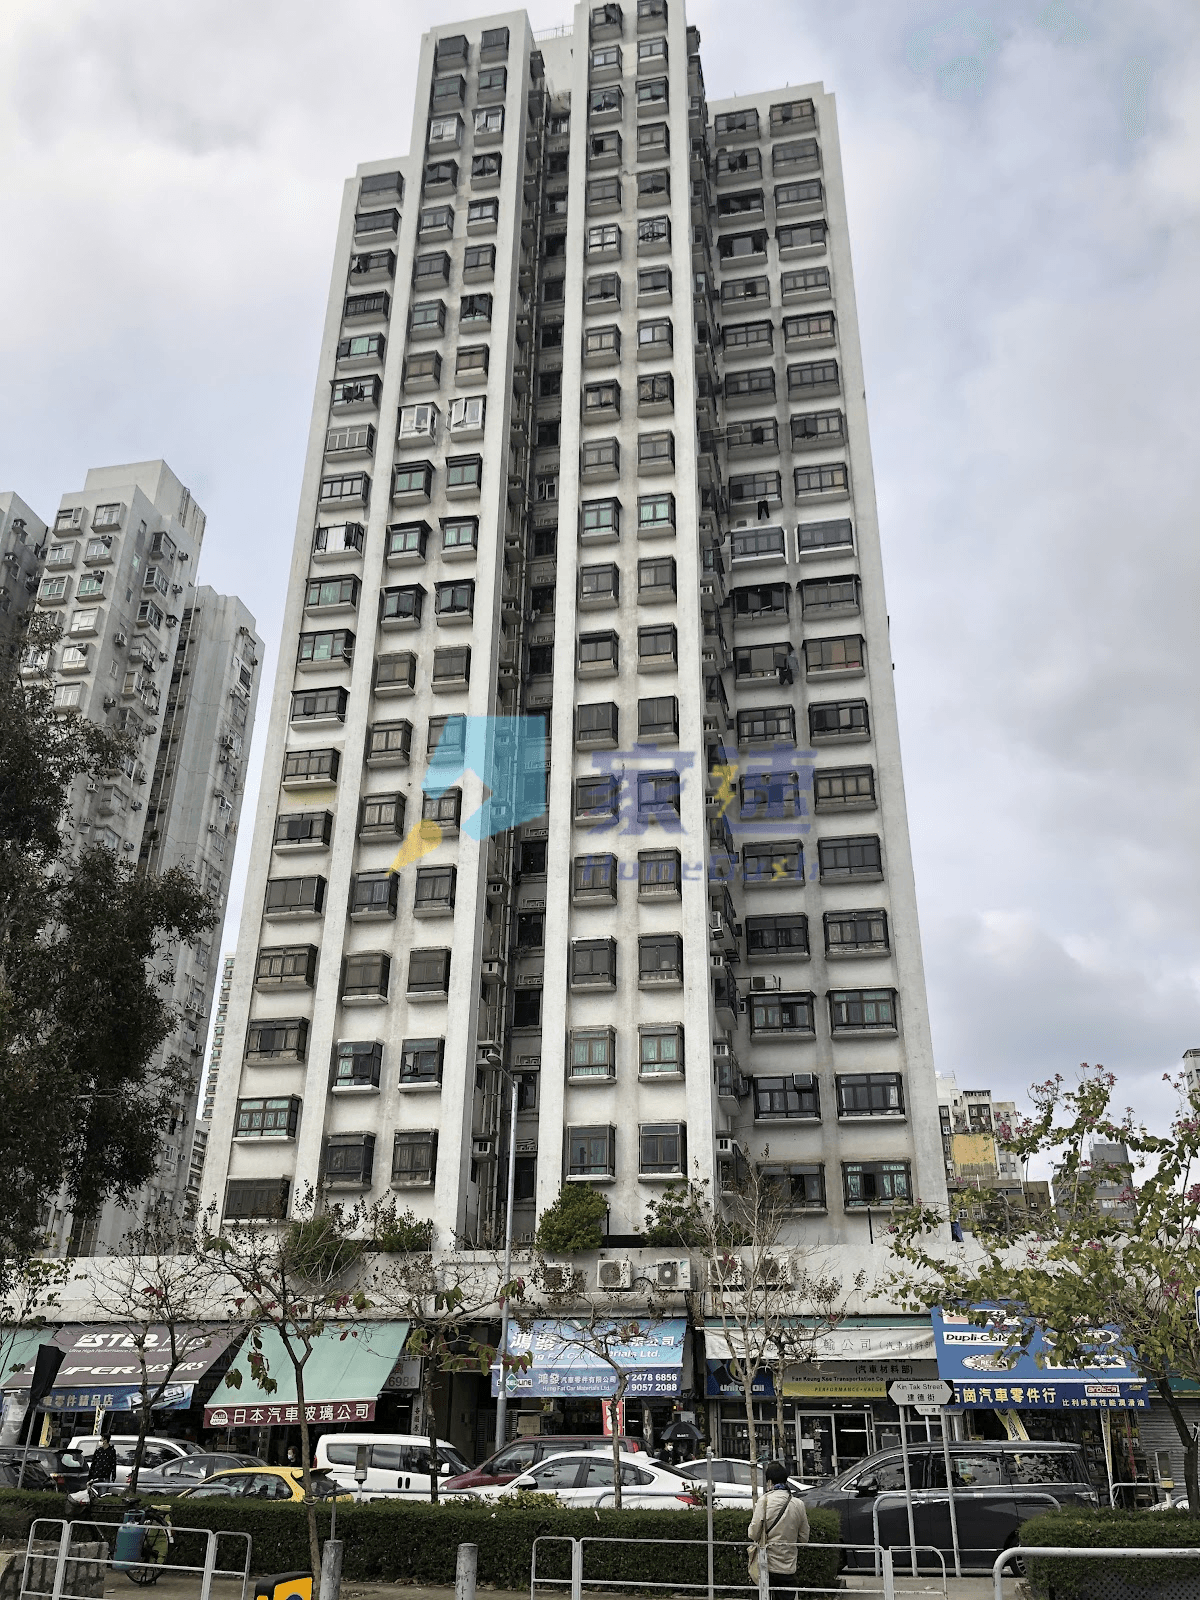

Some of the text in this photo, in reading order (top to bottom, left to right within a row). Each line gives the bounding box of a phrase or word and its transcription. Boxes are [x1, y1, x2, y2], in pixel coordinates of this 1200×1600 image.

[73, 1333, 160, 1348] ESTER
[517, 1351, 545, 1361] Hng
[588, 1350, 637, 1360] Merials
[640, 1350, 661, 1358] Ltd.
[23, 1365, 136, 1376] SPER
[631, 1373, 677, 1381] 2478 6856
[720, 1384, 749, 1392] Unite
[233, 1403, 369, 1425] 日本汽車玻璃公司
